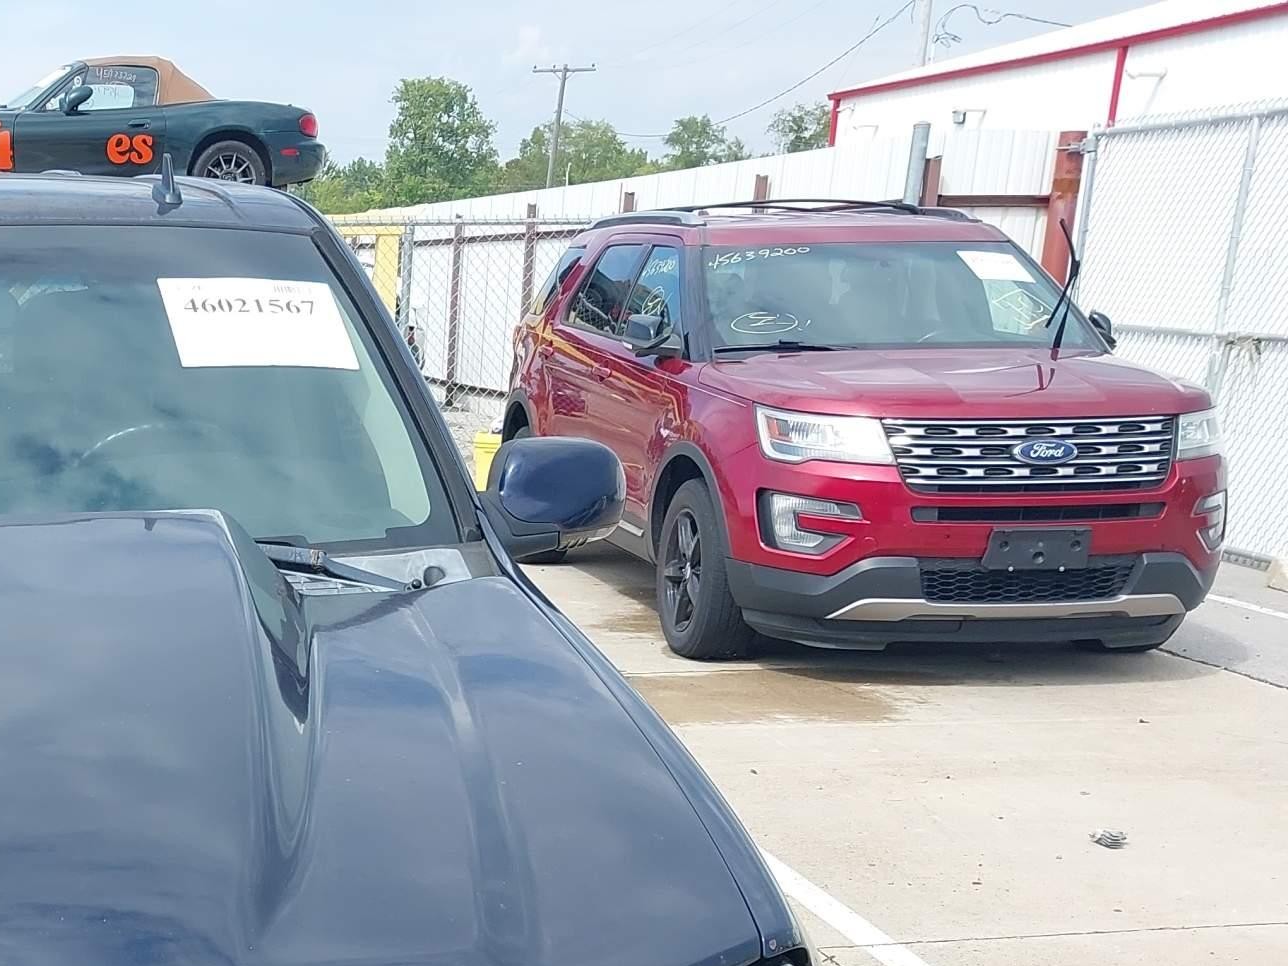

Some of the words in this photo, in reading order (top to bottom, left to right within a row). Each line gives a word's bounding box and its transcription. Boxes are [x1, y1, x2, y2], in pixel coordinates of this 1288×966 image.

[106, 134, 153, 164] es
[708, 246, 810, 269] 45639200
[183, 298, 314, 315] 46021567
[1030, 443, 1065, 458] Ford
